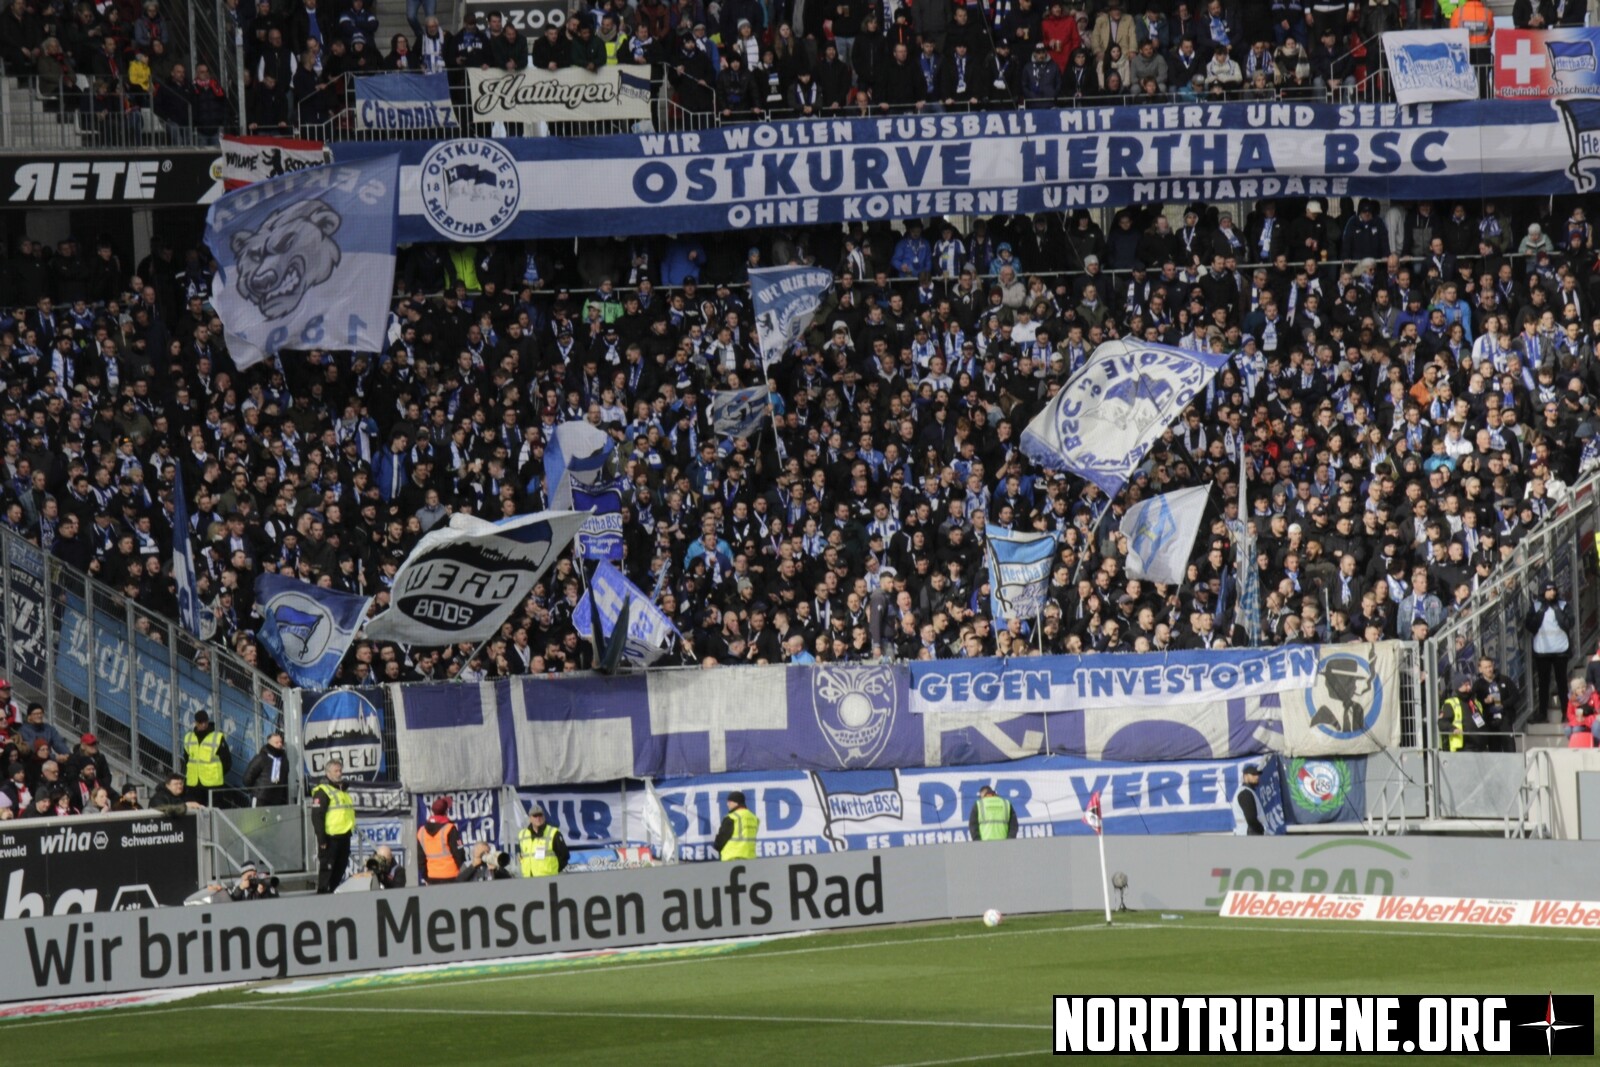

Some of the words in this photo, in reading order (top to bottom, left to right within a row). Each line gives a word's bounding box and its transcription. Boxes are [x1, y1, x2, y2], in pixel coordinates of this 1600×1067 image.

[474, 73, 615, 115] Hattingen
[361, 99, 458, 129] Chemnitz
[640, 133, 701, 156] WIR
[724, 120, 853, 150] WOLLEN
[876, 111, 1037, 141] FUSSBALL
[1060, 108, 1115, 132] MIT
[1138, 105, 1223, 130] HERZ
[1247, 103, 1315, 128] UND
[1338, 103, 1433, 127] SEELE
[428, 143, 511, 175] OSTKURVE
[632, 142, 972, 204] OSTKURVE
[1020, 133, 1277, 184] HERTHA
[1323, 130, 1450, 175] BSC
[427, 182, 440, 192] 18
[499, 179, 515, 190] 92
[428, 197, 487, 234] HERTHA
[489, 195, 516, 227] BSC
[728, 199, 819, 228] OHNE
[844, 187, 1019, 221] KONZERNE
[1042, 183, 1110, 208] UND
[1133, 175, 1349, 202] MILLIARDÄRE
[579, 514, 623, 532] erthaBSC
[918, 671, 1052, 703] GEGEN
[1076, 649, 1316, 698] INVESTOREN
[1070, 764, 1240, 812] VEREI
[3, 835, 15, 845] im
[40, 827, 91, 855] wiha
[121, 832, 185, 848] Schwarzwald
[132, 822, 159, 835] Made
[160, 820, 173, 832] im
[756, 839, 818, 857] ERDEN
[866, 834, 891, 849] ES
[24, 920, 123, 987] Wir
[139, 912, 358, 980] bringen
[376, 881, 645, 959] Menschen
[662, 865, 774, 933] aufs
[788, 854, 885, 922] Rad
[1228, 892, 1365, 920] WeberHaus
[1375, 895, 1517, 925] WeberHaus
[1529, 900, 1600, 927] Webe
